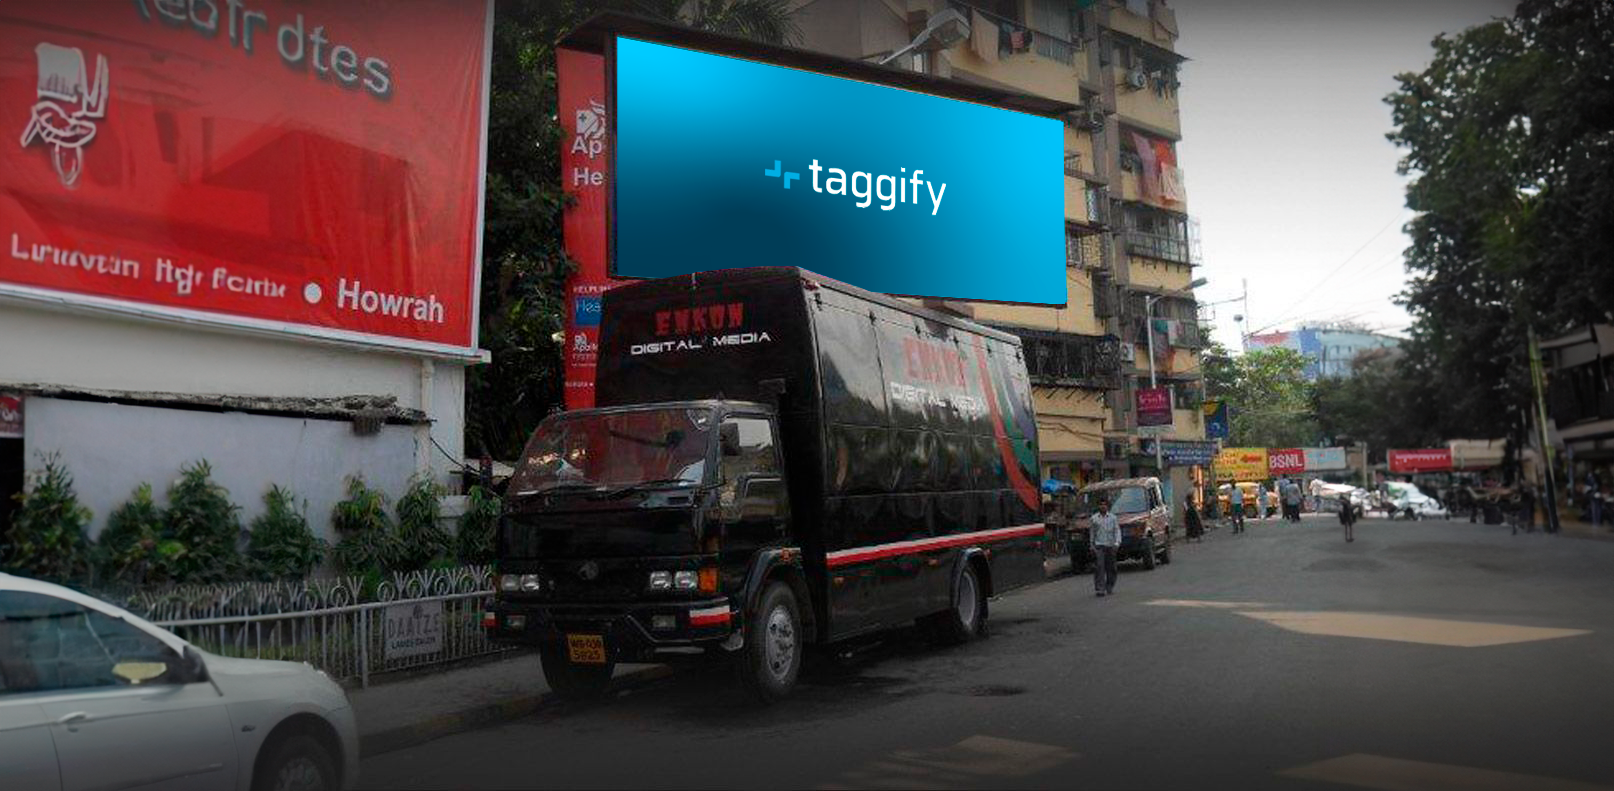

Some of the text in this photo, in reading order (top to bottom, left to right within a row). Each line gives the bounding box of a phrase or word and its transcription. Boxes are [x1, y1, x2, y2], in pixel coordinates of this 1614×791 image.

[809, 158, 946, 216] taggify
[337, 277, 444, 323] Howrah
[630, 331, 772, 356] DIGITAL MEDIA
[1268, 454, 1304, 470] BSNL
